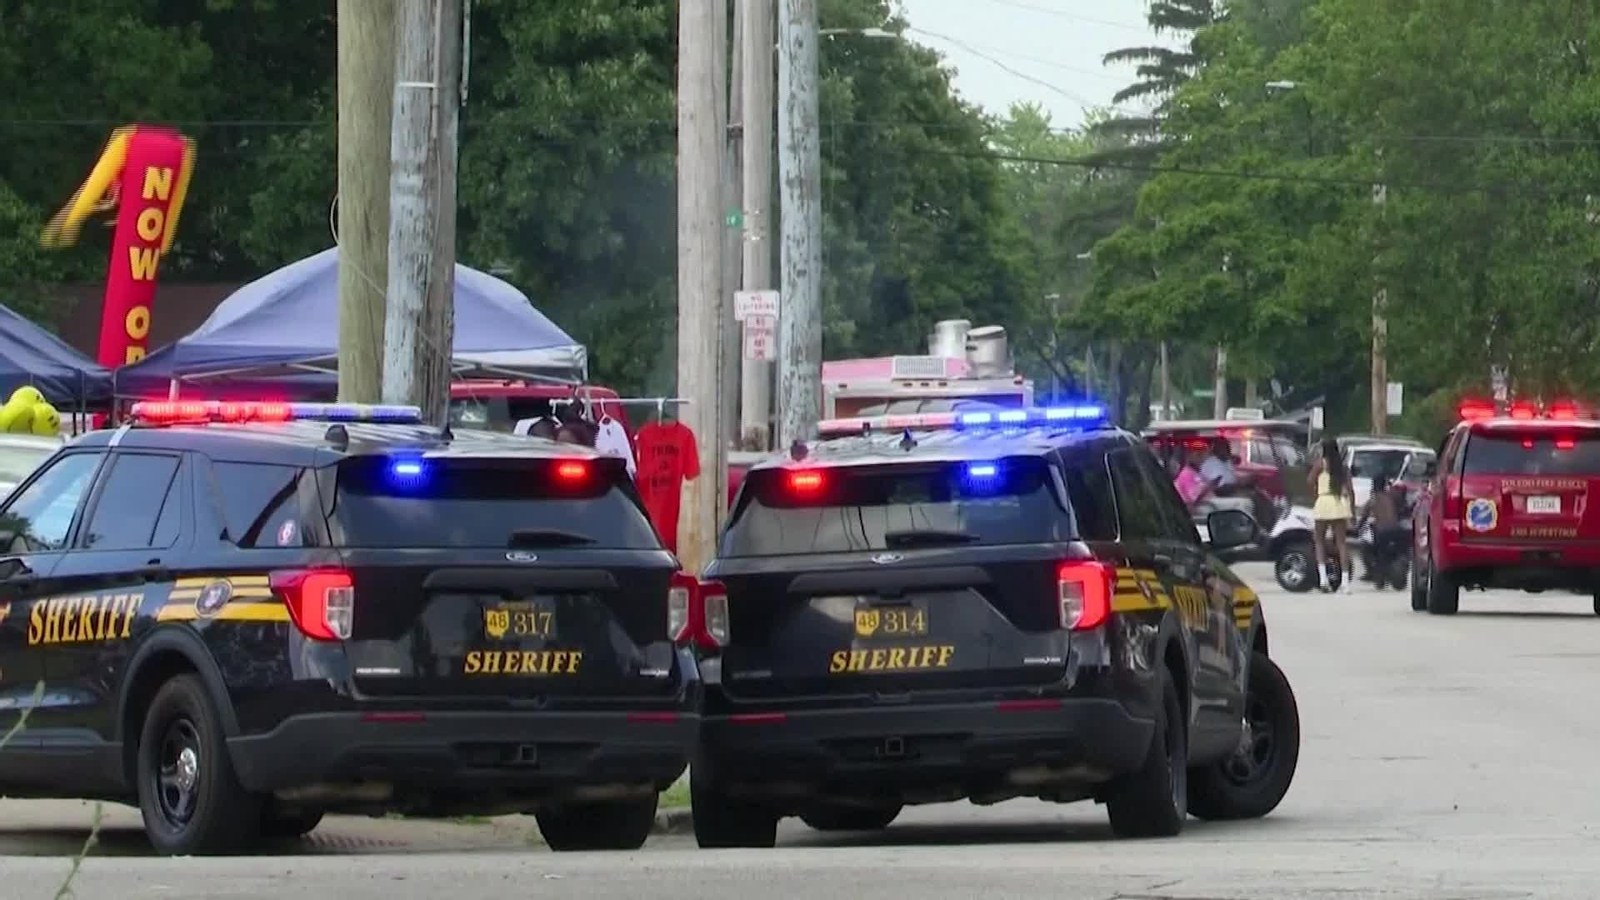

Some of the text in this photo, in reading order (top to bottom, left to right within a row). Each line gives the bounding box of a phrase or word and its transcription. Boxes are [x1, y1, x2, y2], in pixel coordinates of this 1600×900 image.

[129, 166, 174, 281] NOW
[28, 593, 145, 645] SHERIFF
[488, 612, 552, 635] 48 317
[858, 609, 925, 633] 48 314
[464, 651, 583, 673] SHERIFF
[829, 646, 955, 673] SHERIFF
